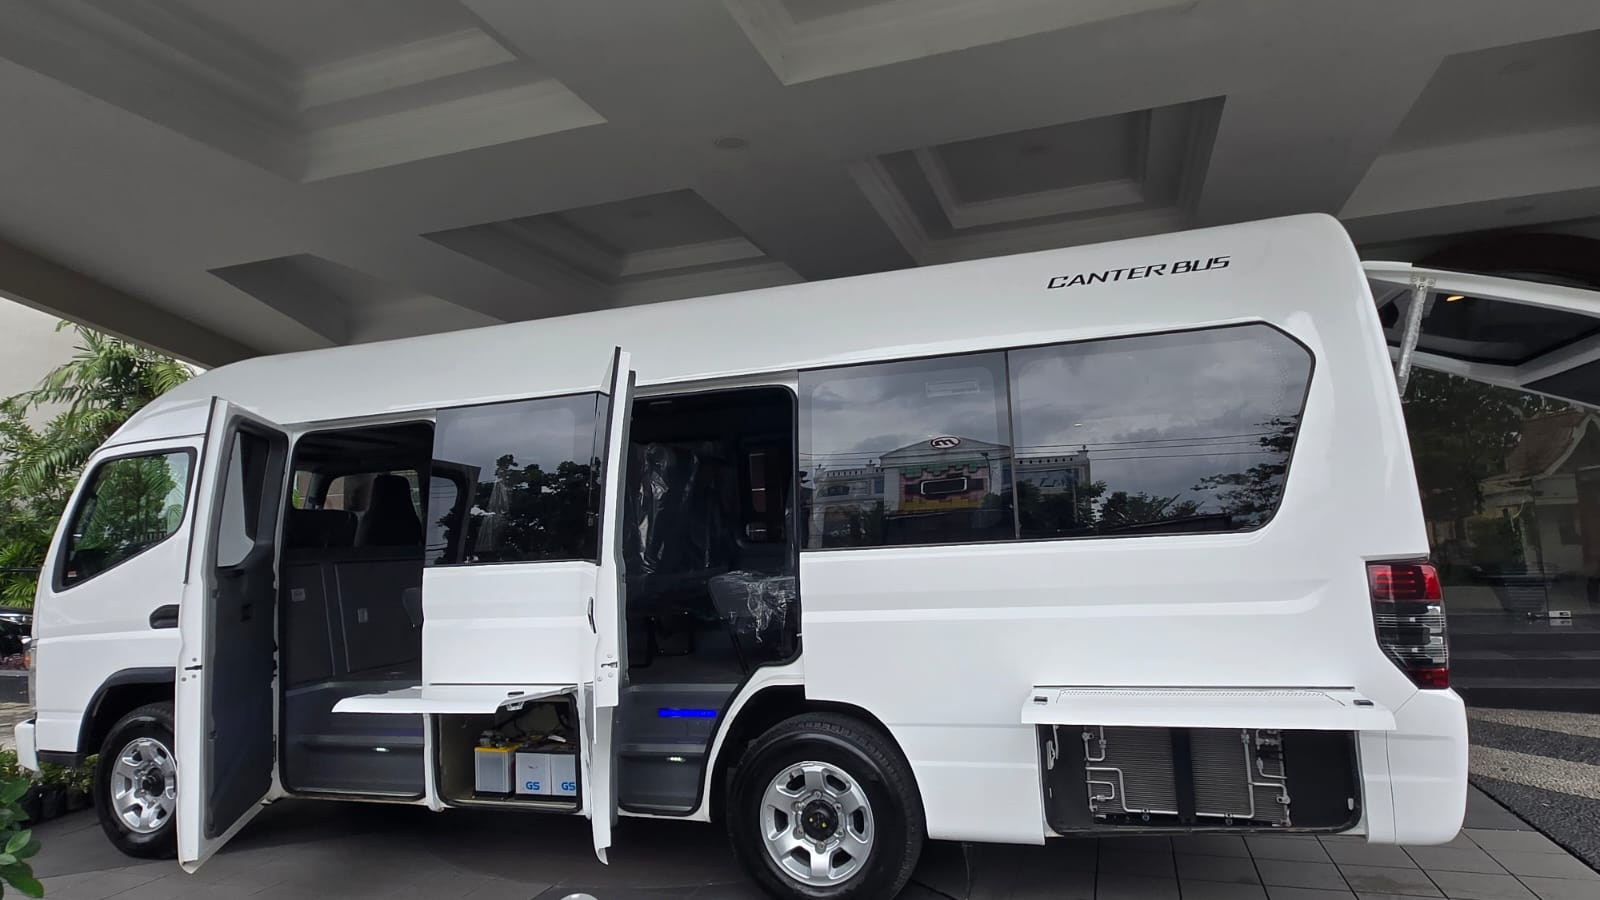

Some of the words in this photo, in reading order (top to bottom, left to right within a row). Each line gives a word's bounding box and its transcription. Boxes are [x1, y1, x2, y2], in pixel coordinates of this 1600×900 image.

[1047, 263, 1167, 289] CANTER
[1170, 256, 1231, 274] BUS
[525, 781, 541, 791] GS
[561, 781, 576, 791] GS
